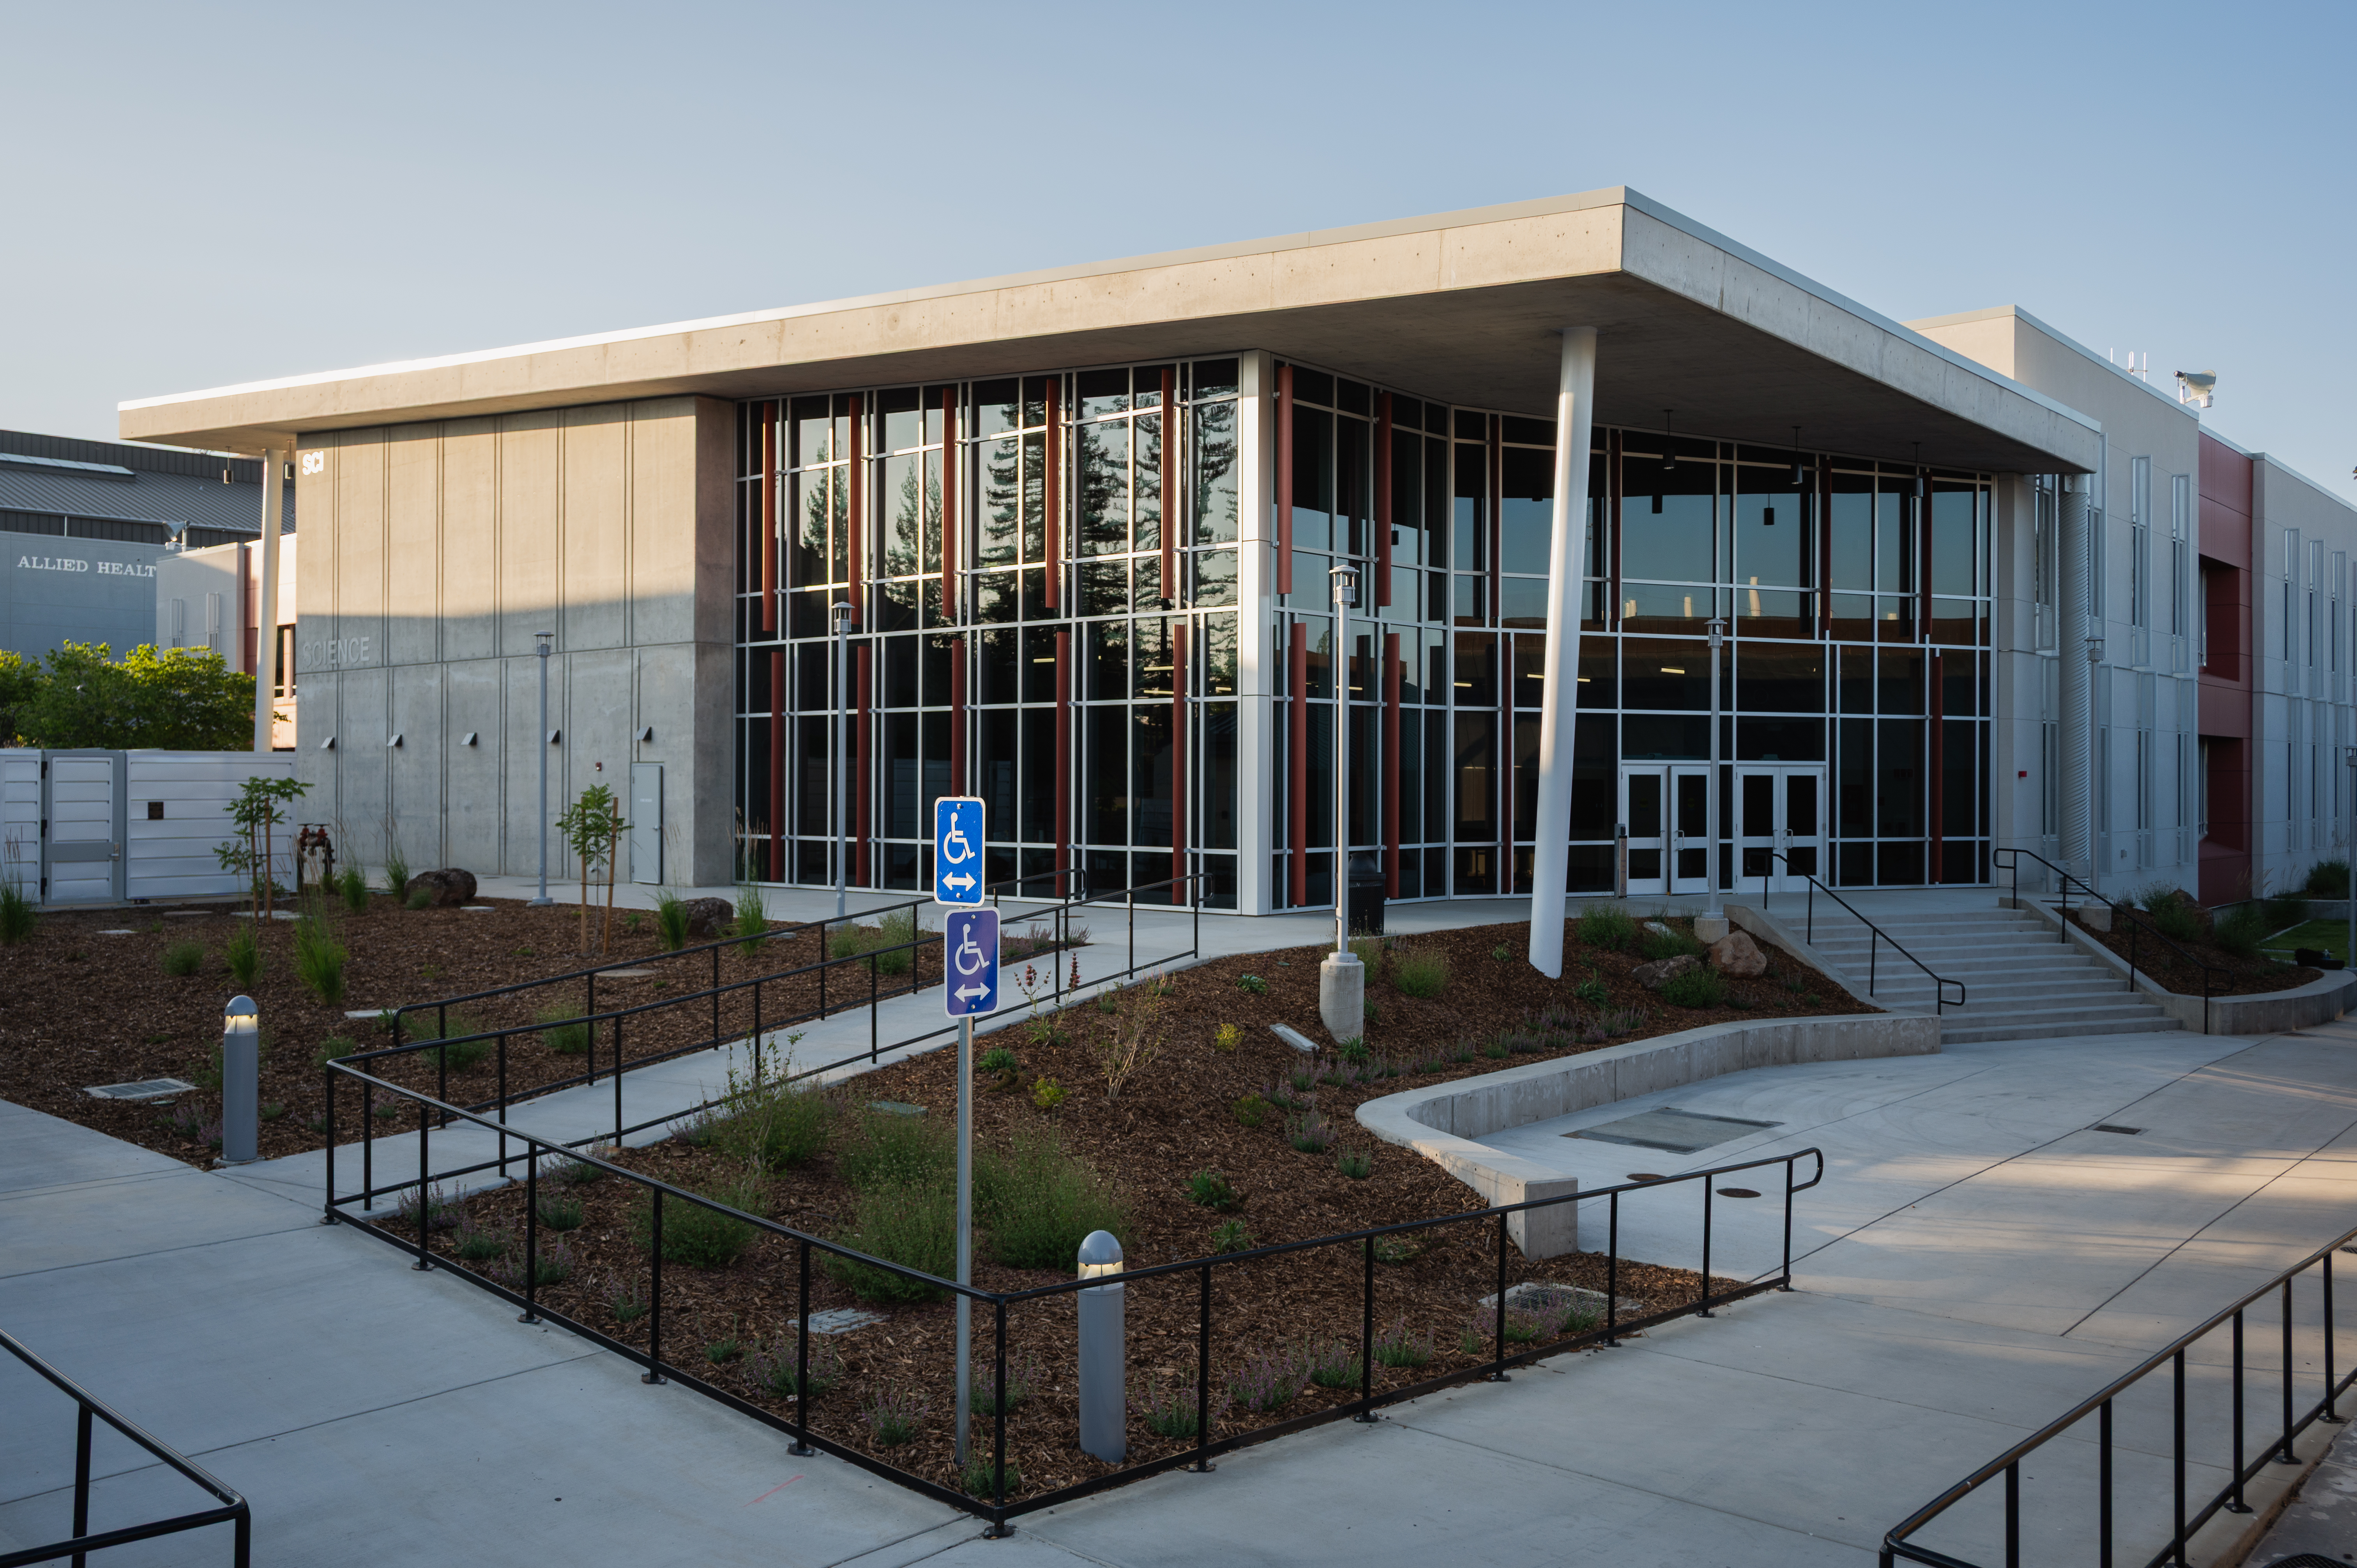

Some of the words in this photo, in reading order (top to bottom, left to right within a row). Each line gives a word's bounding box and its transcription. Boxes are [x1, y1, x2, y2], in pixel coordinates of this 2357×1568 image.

[302, 451, 324, 475] SCI
[18, 556, 88, 572] ALLIED
[303, 637, 369, 667] SCIENCE
